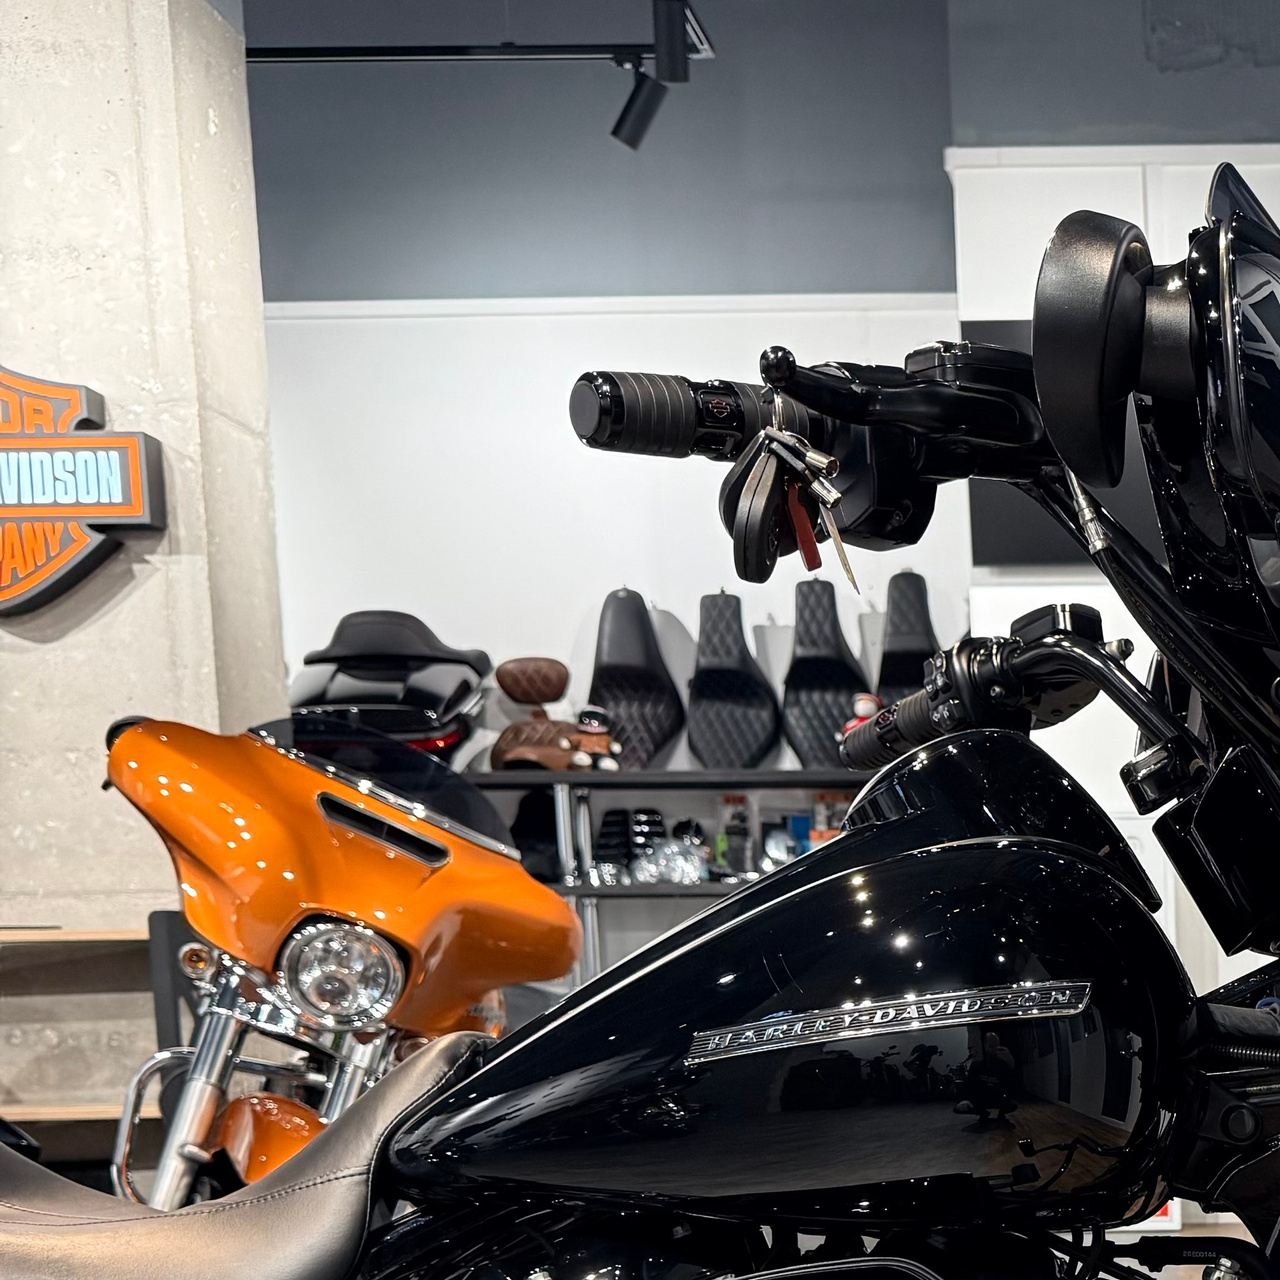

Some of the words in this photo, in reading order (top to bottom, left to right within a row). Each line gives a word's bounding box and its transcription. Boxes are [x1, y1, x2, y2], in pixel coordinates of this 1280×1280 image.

[0, 451, 123, 504] VIDSON
[0, 521, 65, 586] ANY
[708, 990, 1072, 1050] HARLEY-DAVIDSON
